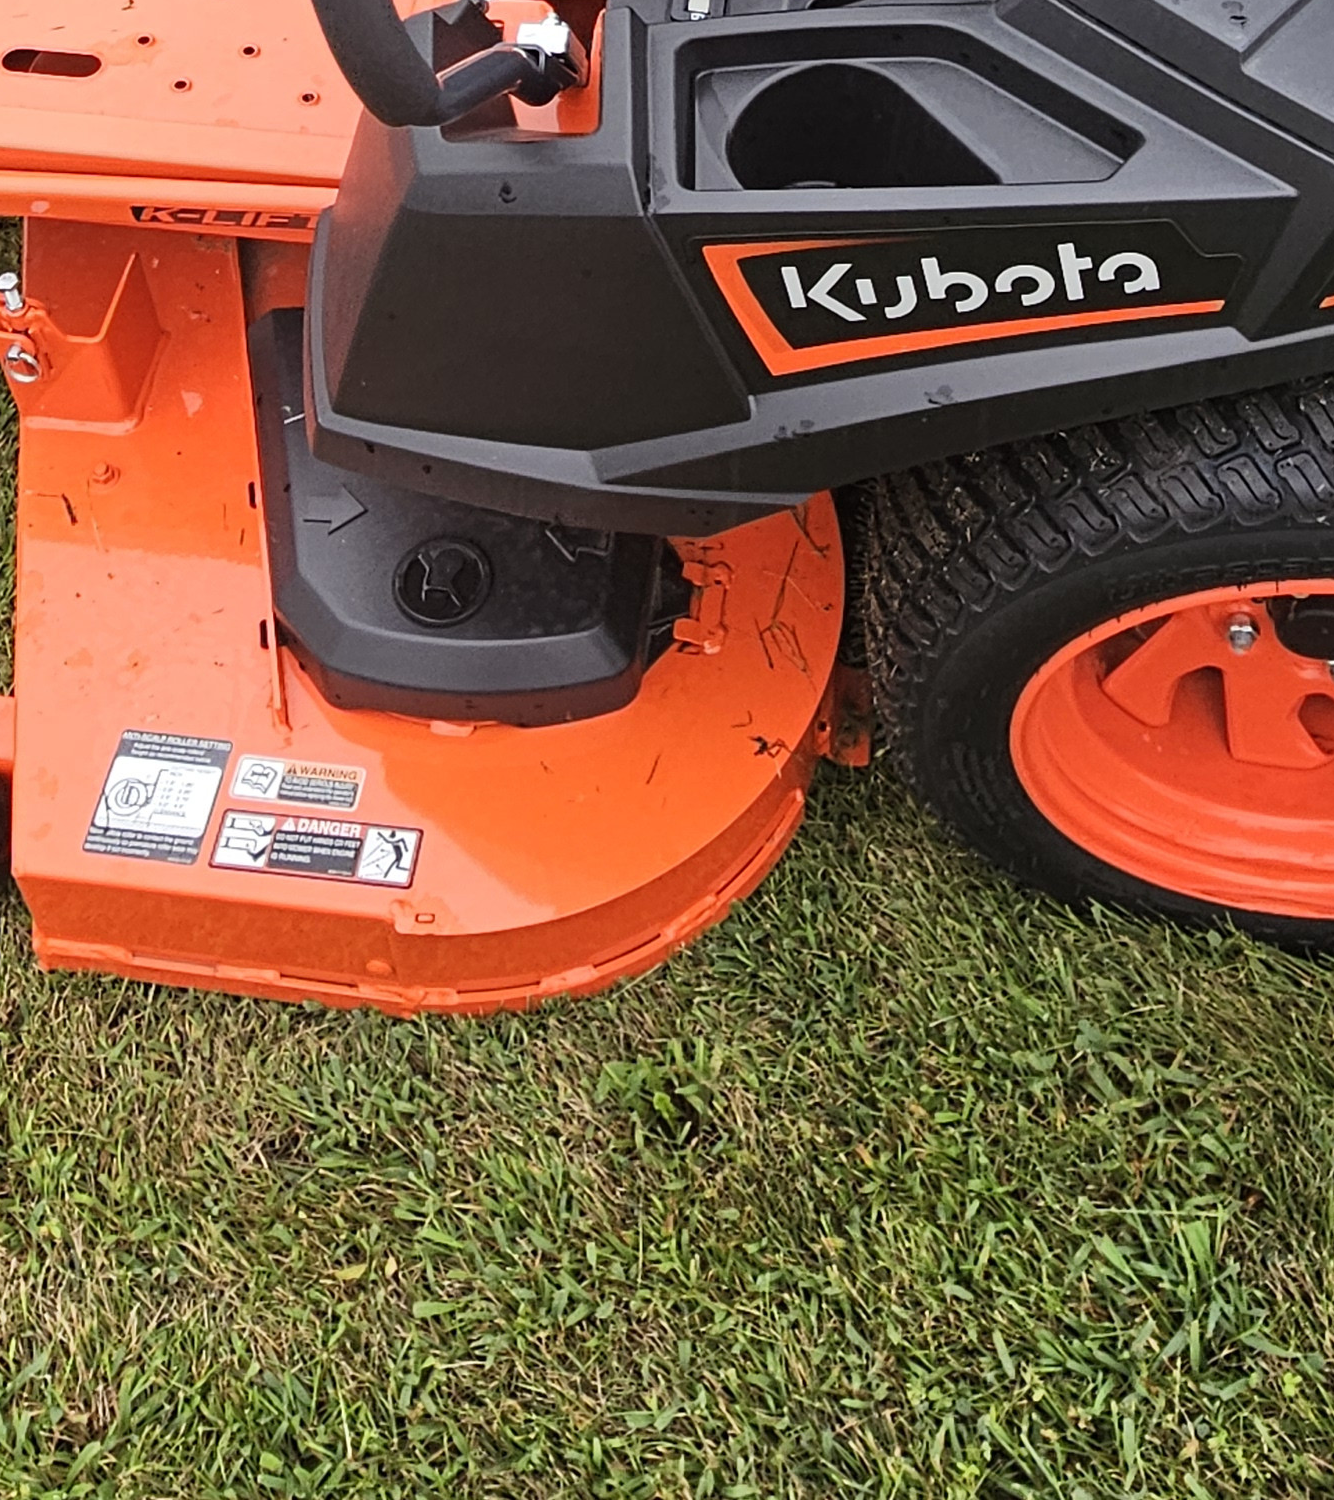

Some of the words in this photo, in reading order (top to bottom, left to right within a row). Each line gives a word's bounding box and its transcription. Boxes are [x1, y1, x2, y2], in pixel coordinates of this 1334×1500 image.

[139, 206, 318, 228] K-LIFT
[781, 242, 1161, 322] Kubota
[300, 766, 359, 781] WARNING
[297, 820, 362, 838] DANGER
